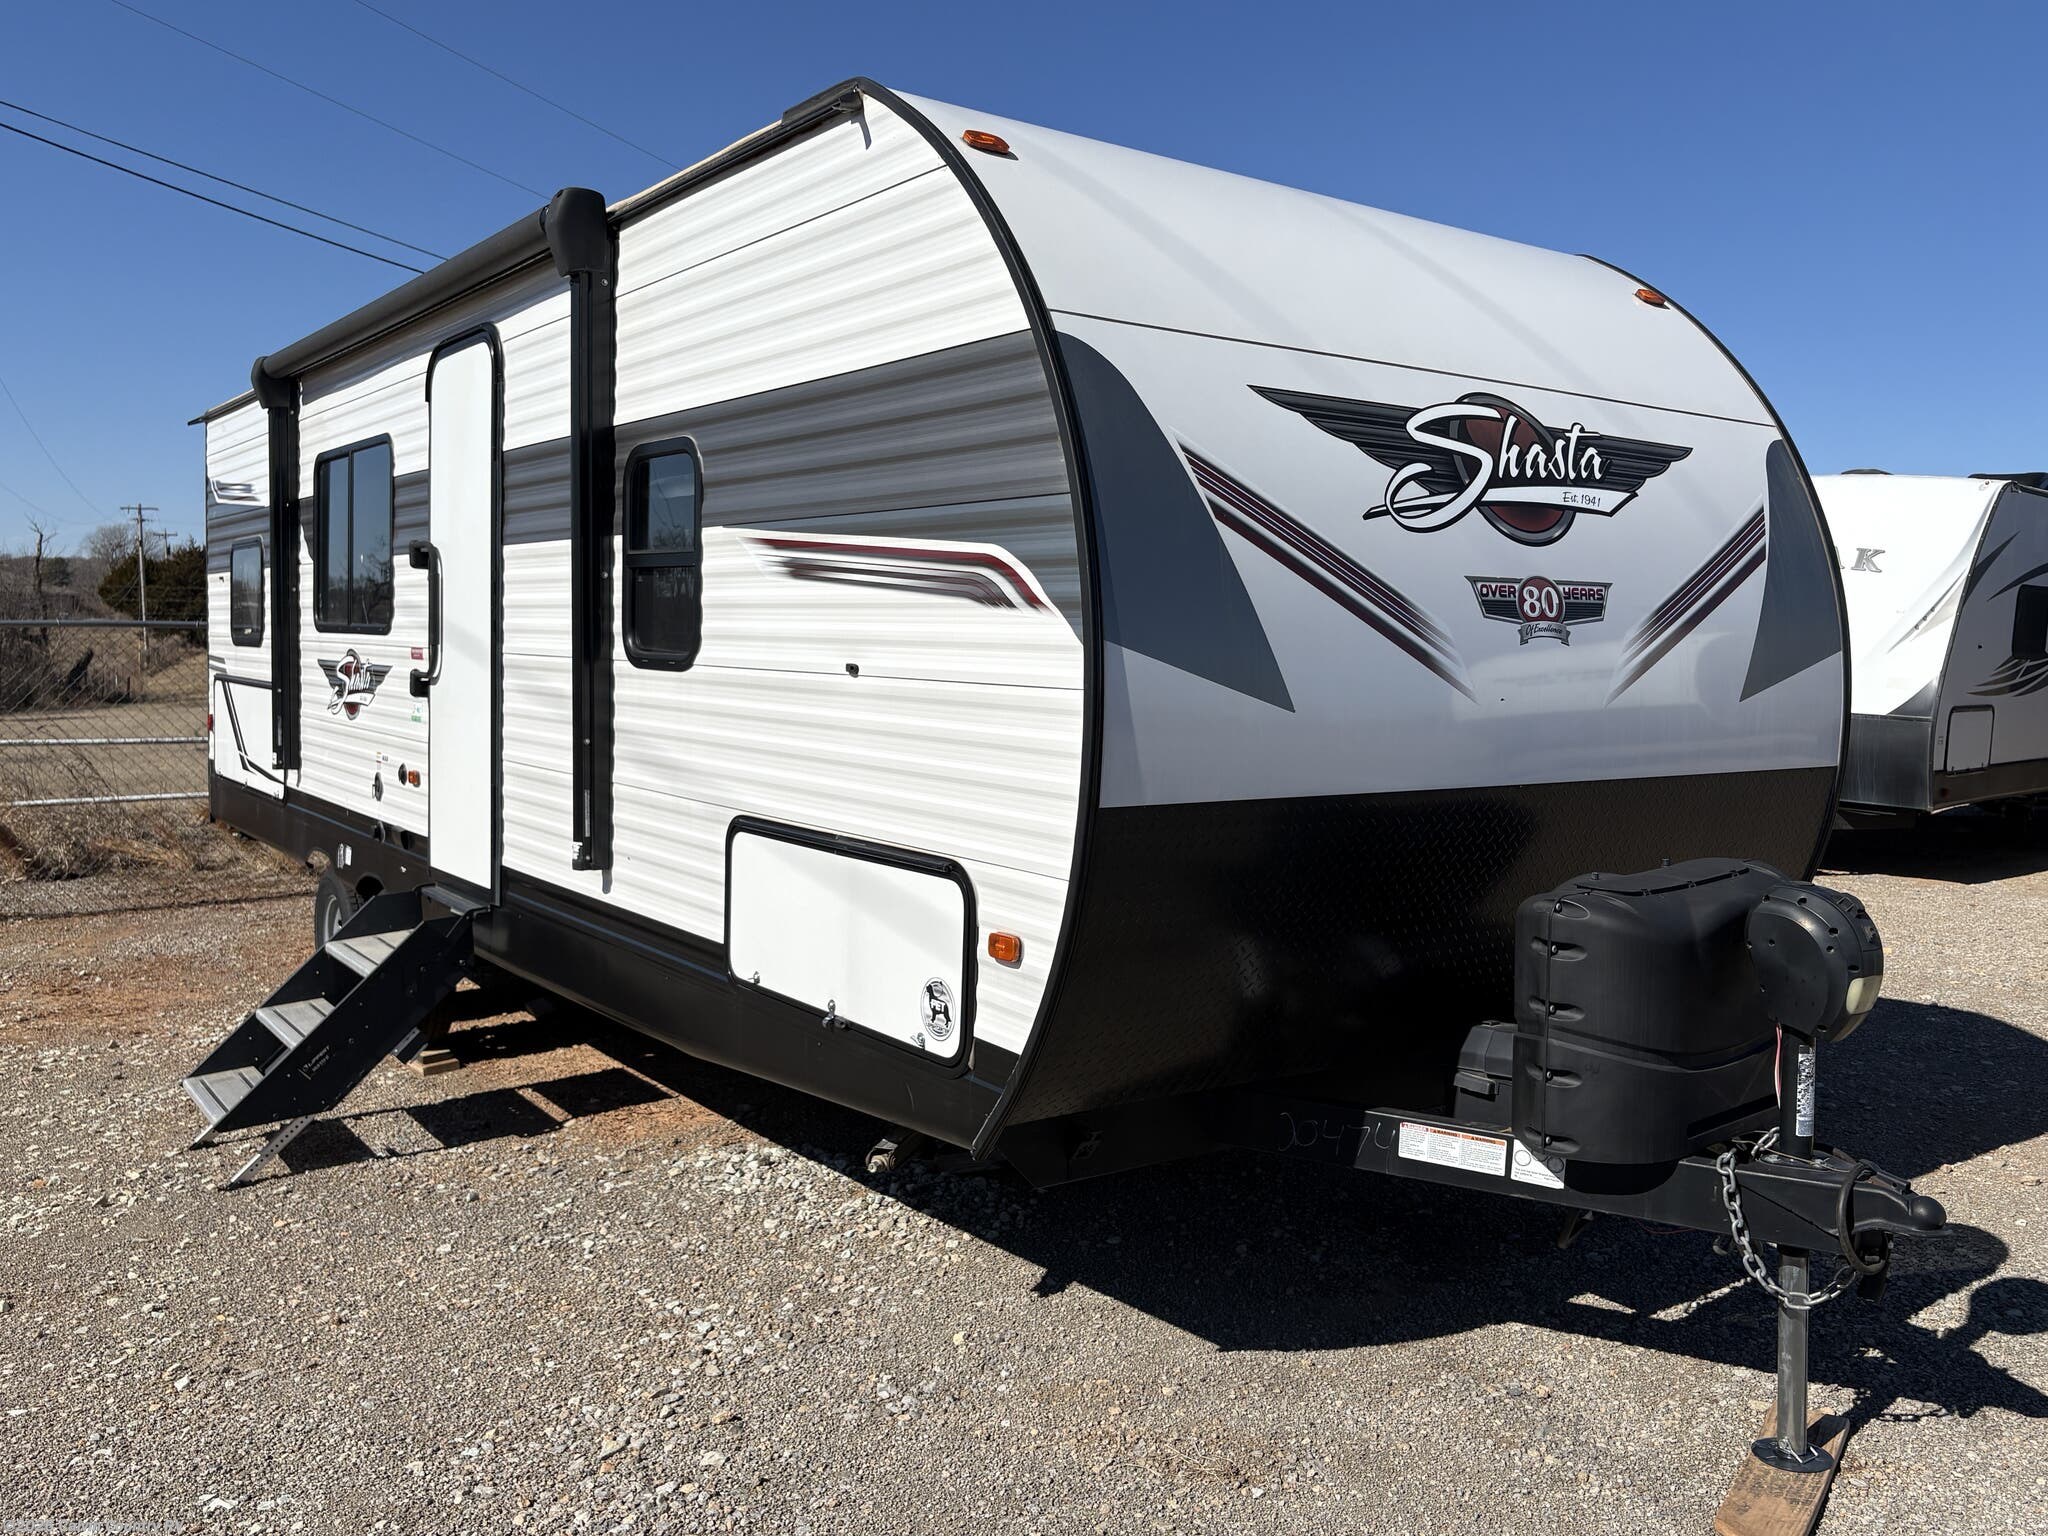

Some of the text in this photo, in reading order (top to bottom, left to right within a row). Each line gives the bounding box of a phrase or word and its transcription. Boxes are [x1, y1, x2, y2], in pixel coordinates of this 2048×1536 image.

[1384, 401, 1604, 533] Shasta
[1562, 491, 1601, 507] Est. 1941
[1480, 583, 1604, 618] OVER 80 YEARS
[1534, 623, 1563, 635] Excellence
[329, 655, 374, 715] Shasta
[931, 999, 946, 1013] PET
